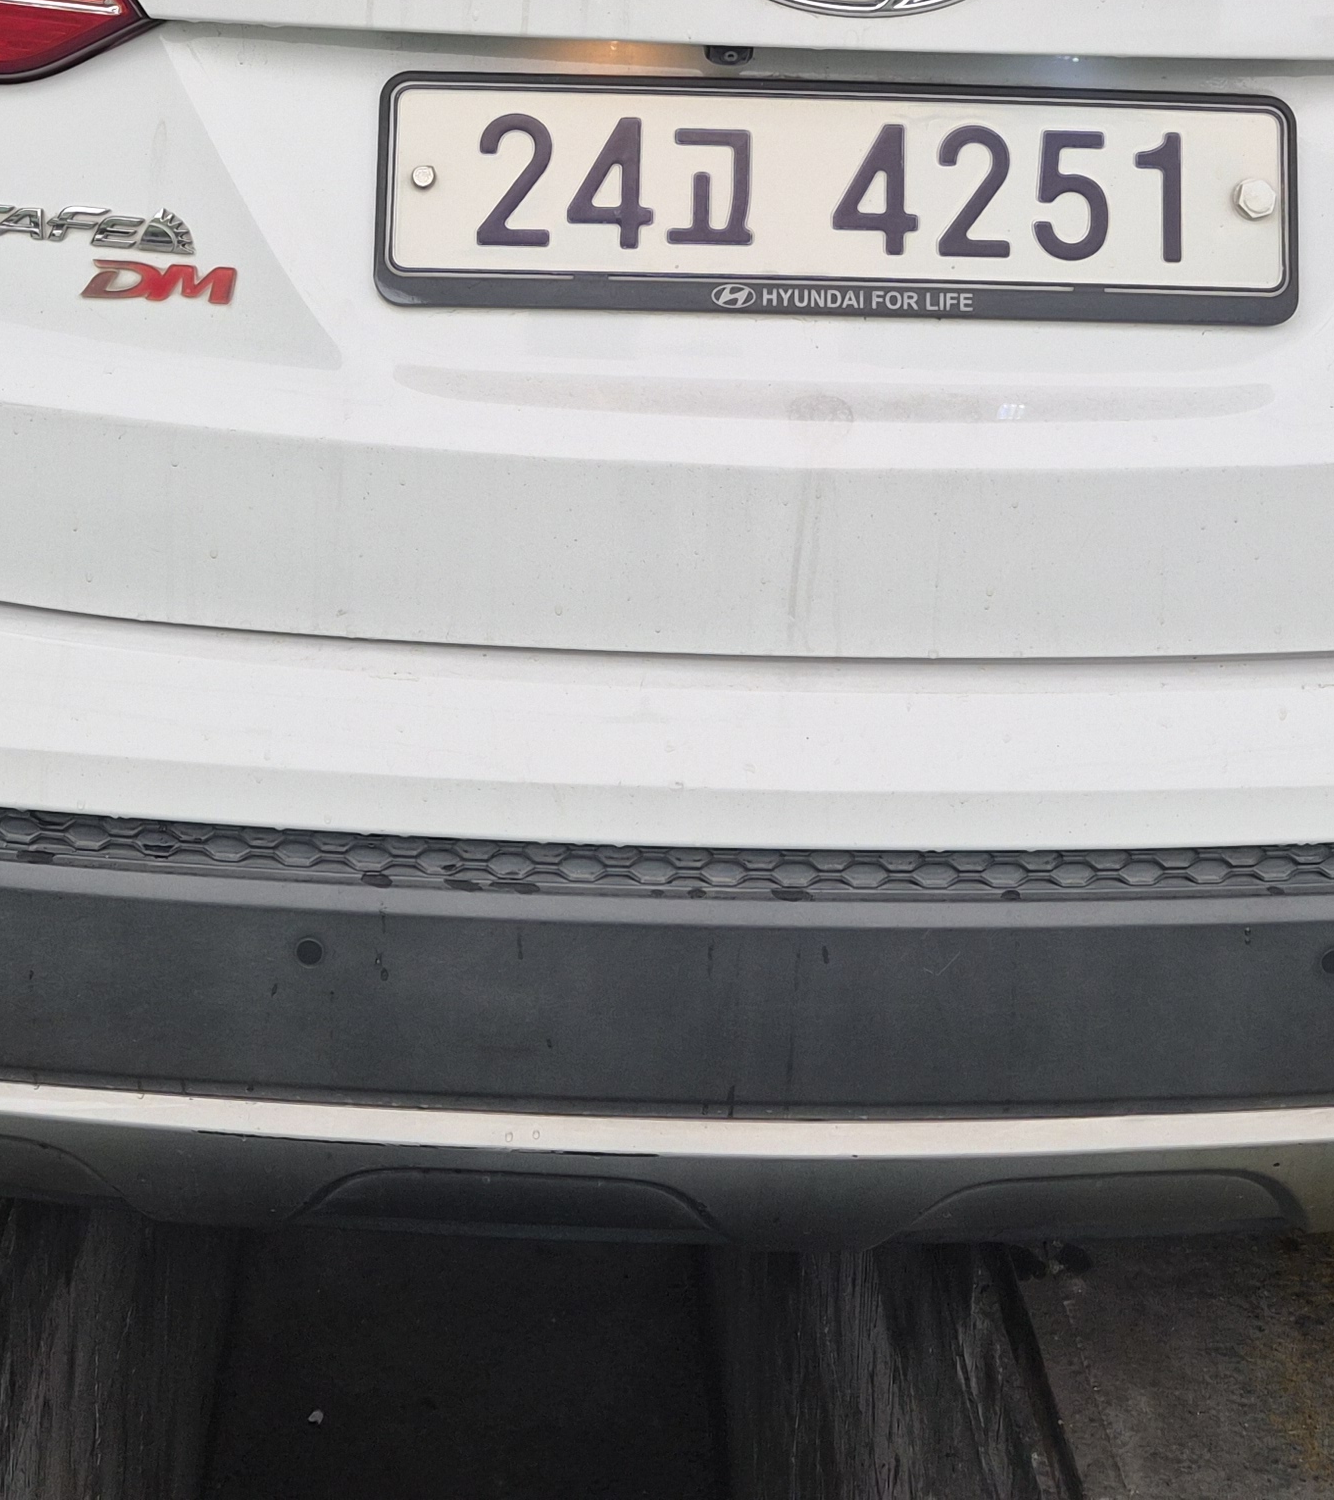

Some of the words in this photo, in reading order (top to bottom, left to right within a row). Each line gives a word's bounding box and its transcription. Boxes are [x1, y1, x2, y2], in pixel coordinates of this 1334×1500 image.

[475, 112, 754, 250] 24고
[832, 123, 1182, 264] 4251
[79, 258, 238, 305] DM
[762, 287, 865, 309] HYUNDAI
[871, 290, 919, 310] FOR
[925, 292, 974, 312] LIFE
